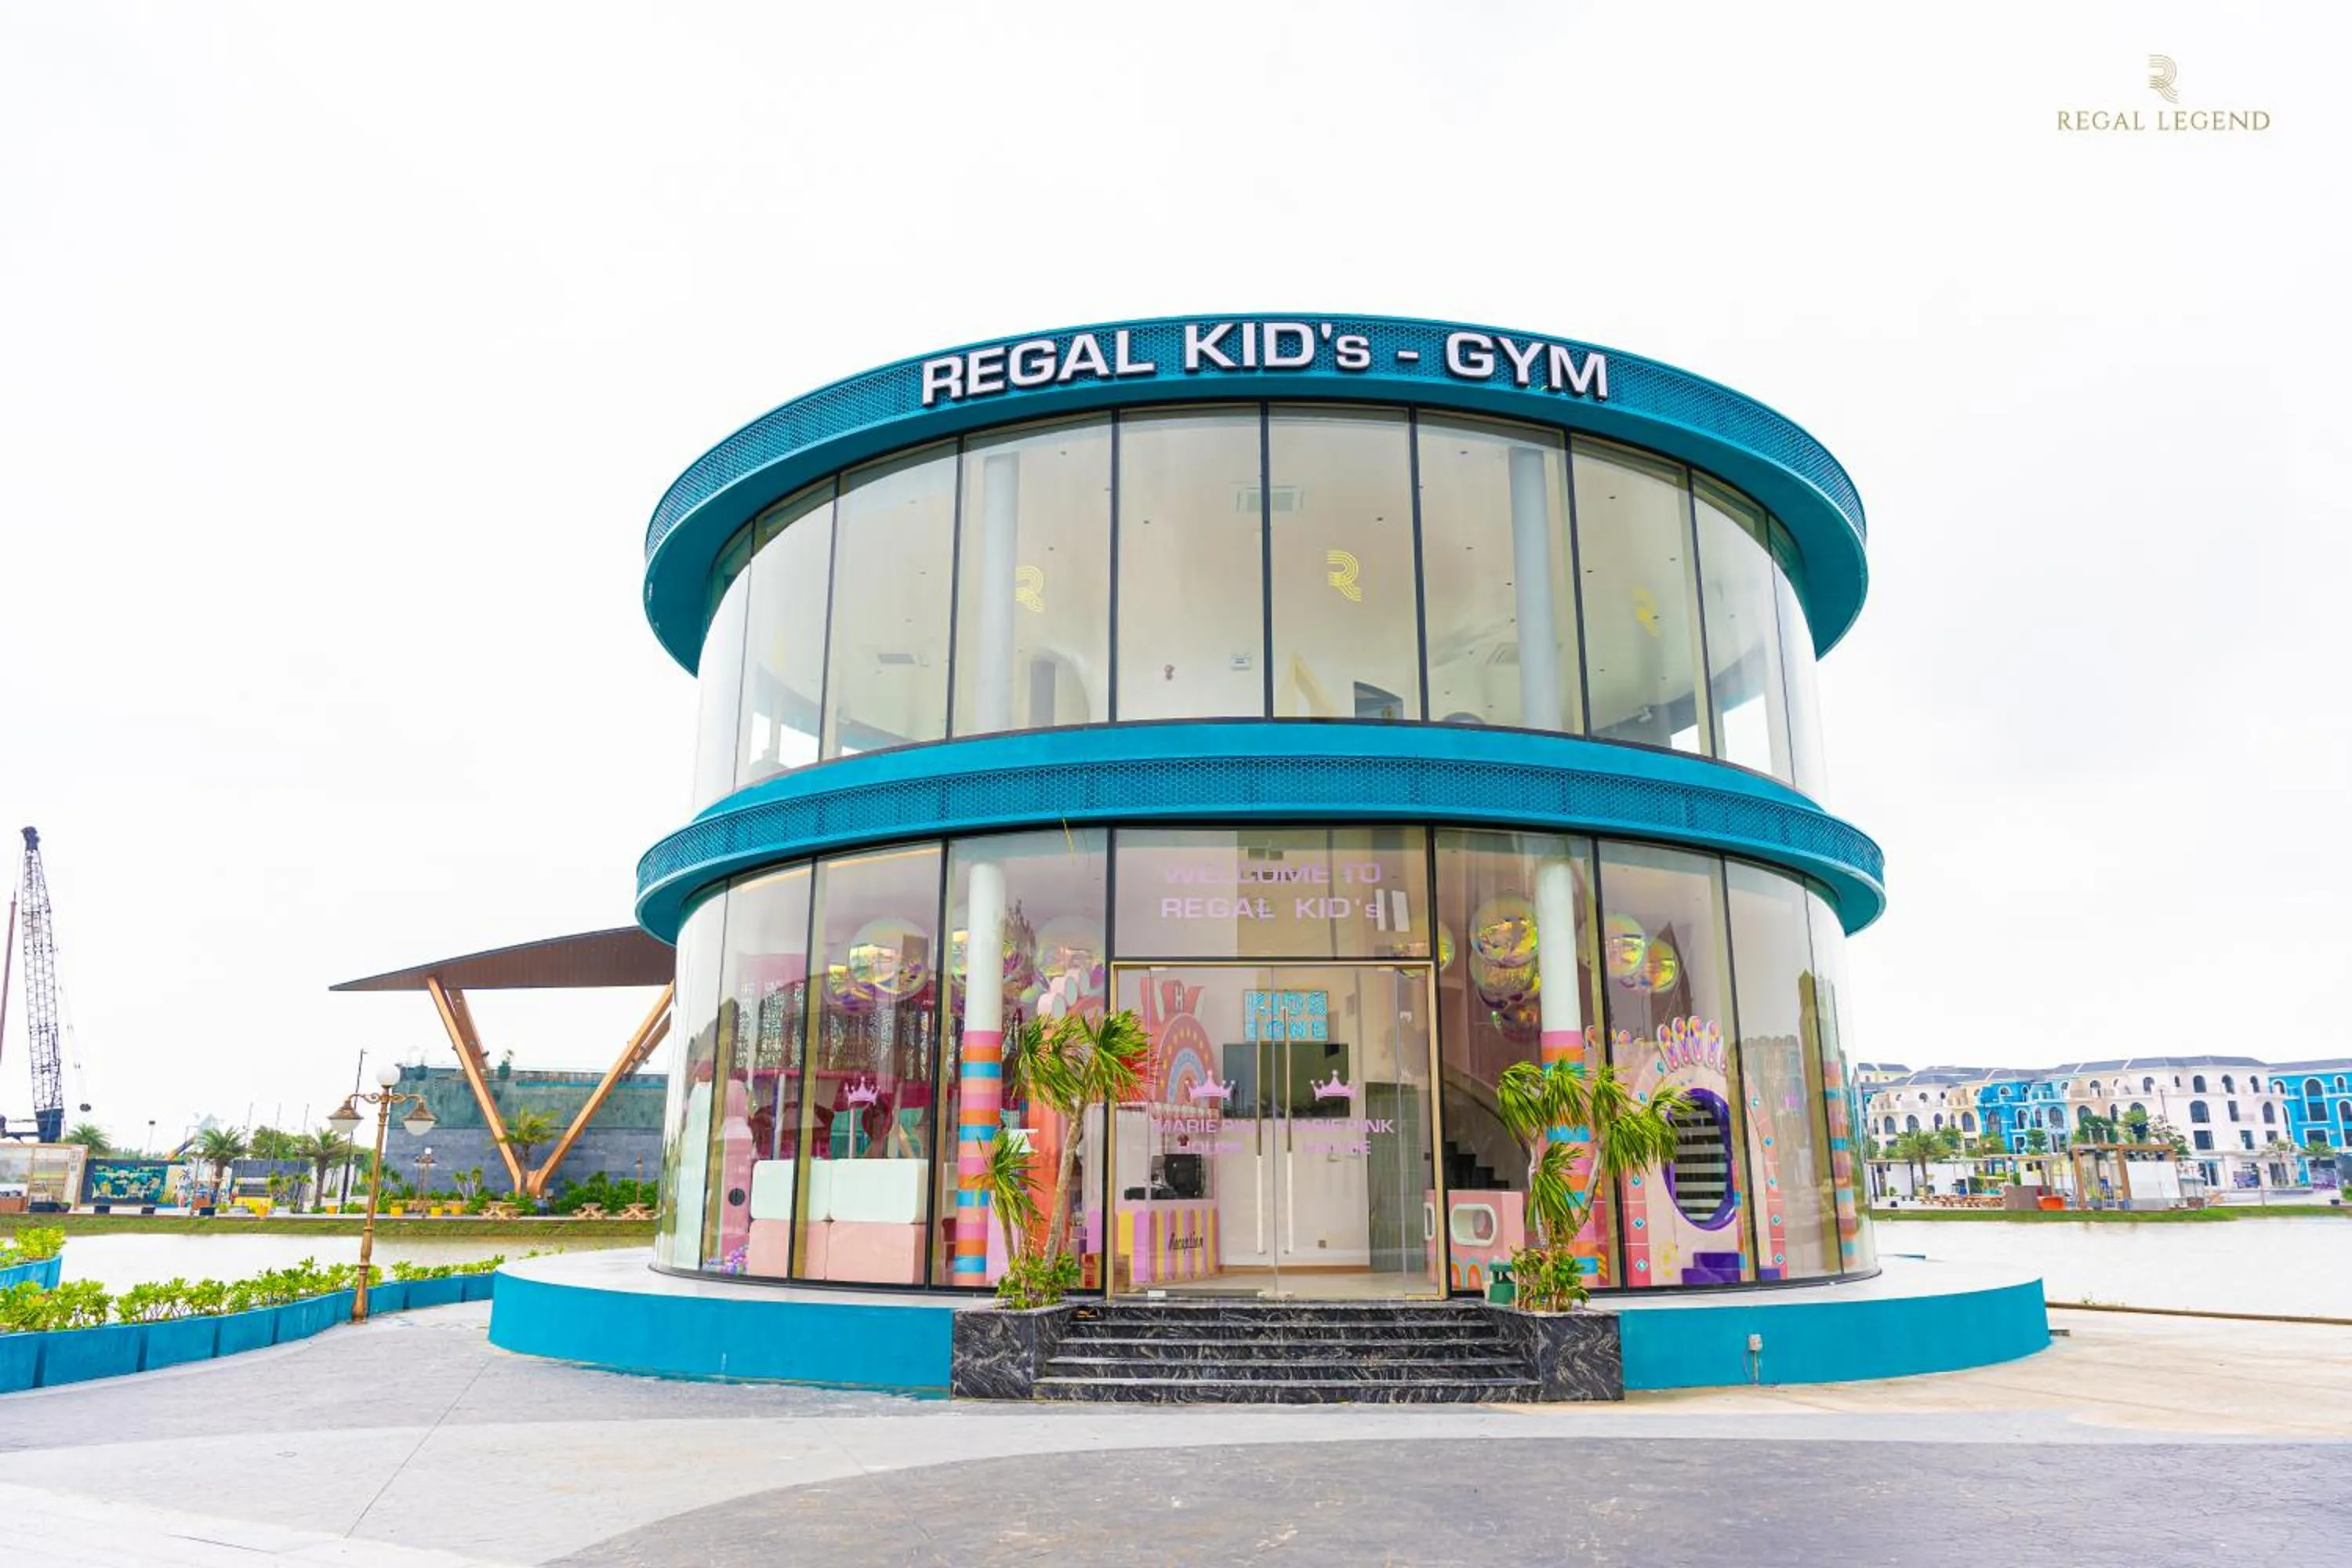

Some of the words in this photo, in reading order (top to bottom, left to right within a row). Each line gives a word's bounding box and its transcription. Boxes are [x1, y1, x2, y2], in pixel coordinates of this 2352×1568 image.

[921, 330, 1156, 405] REGAL
[1185, 322, 1370, 371] KID's
[1445, 331, 1608, 402] GYM
[1164, 863, 1330, 884] WELCOME
[1343, 863, 1381, 884] TO
[1160, 897, 1276, 919] REGAL
[1295, 897, 1381, 919] KID's
[1156, 1119, 1217, 1134] MARIE
